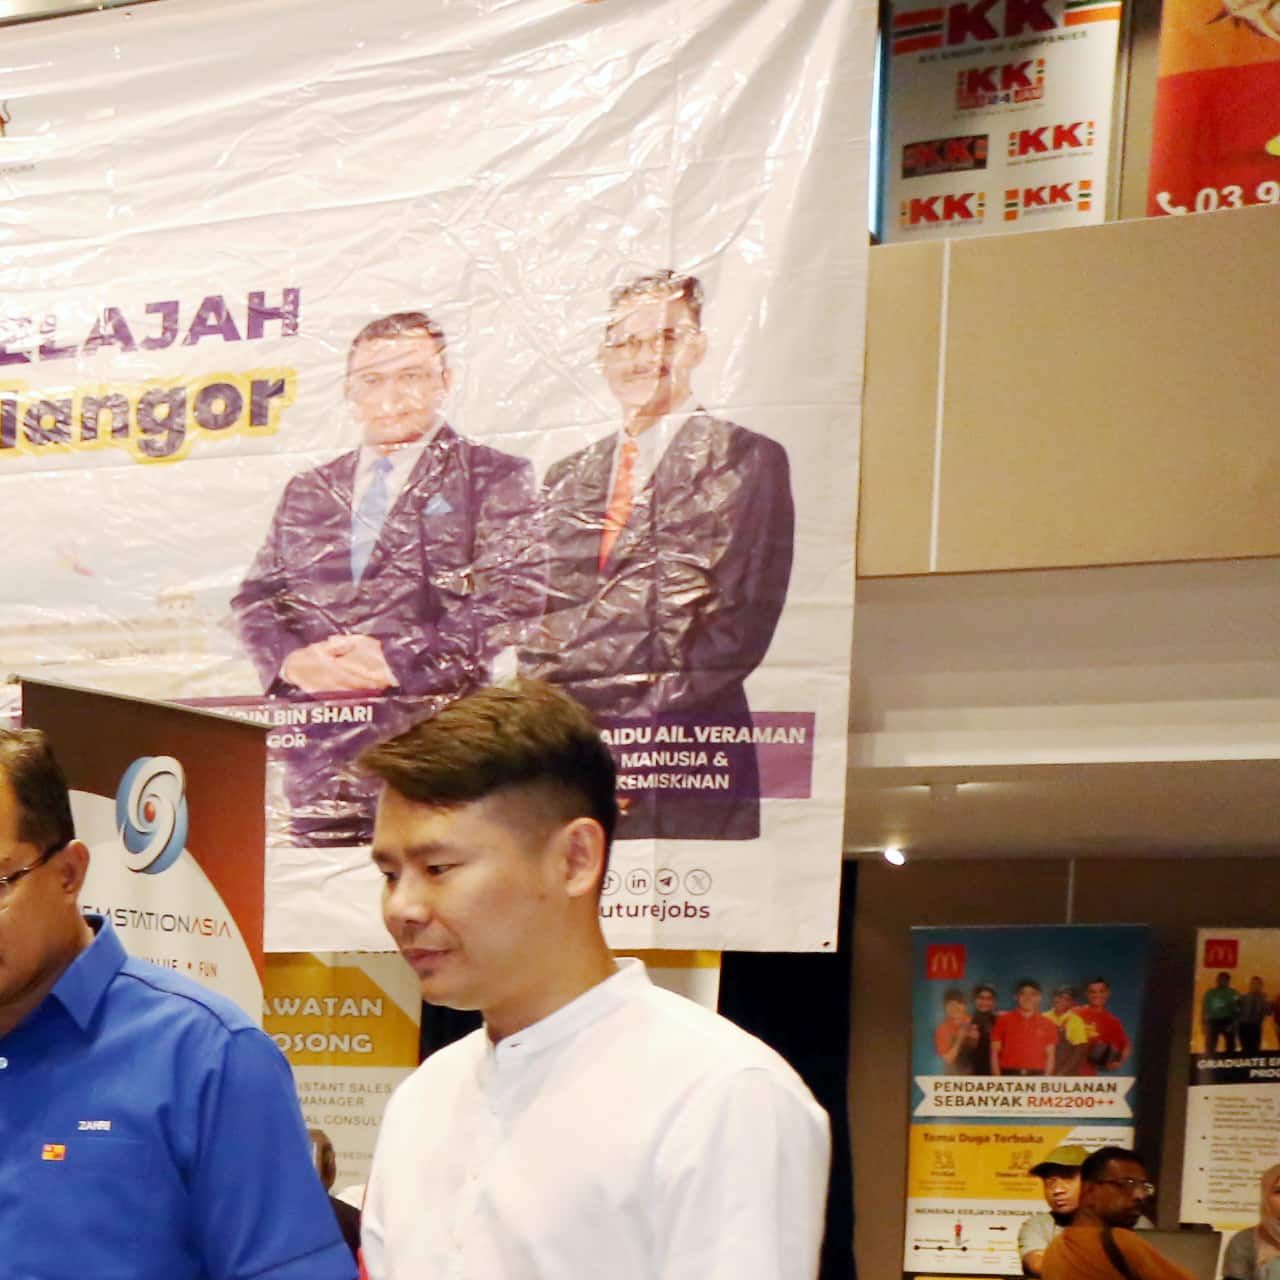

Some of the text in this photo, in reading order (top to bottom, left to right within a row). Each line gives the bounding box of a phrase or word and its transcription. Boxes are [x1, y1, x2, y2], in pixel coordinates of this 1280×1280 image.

[1018, 122, 1082, 156] KK
[1024, 183, 1073, 207] KK
[1196, 185, 1243, 213] 03
[910, 192, 975, 225] KK
[274, 709, 307, 725] BIN
[311, 705, 373, 724] SHARI
[266, 732, 307, 749] GOR
[621, 751, 729, 768] MANUSIA &
[615, 773, 730, 791] KEMISKINAN
[199, 961, 217, 977] FUN
[349, 1081, 392, 1095] SALES
[934, 1081, 1118, 1093] PENDAPATAN BULANAN
[934, 1095, 1115, 1109] SEBANYAK RM2200++
[324, 1114, 382, 1127] CONSUL
